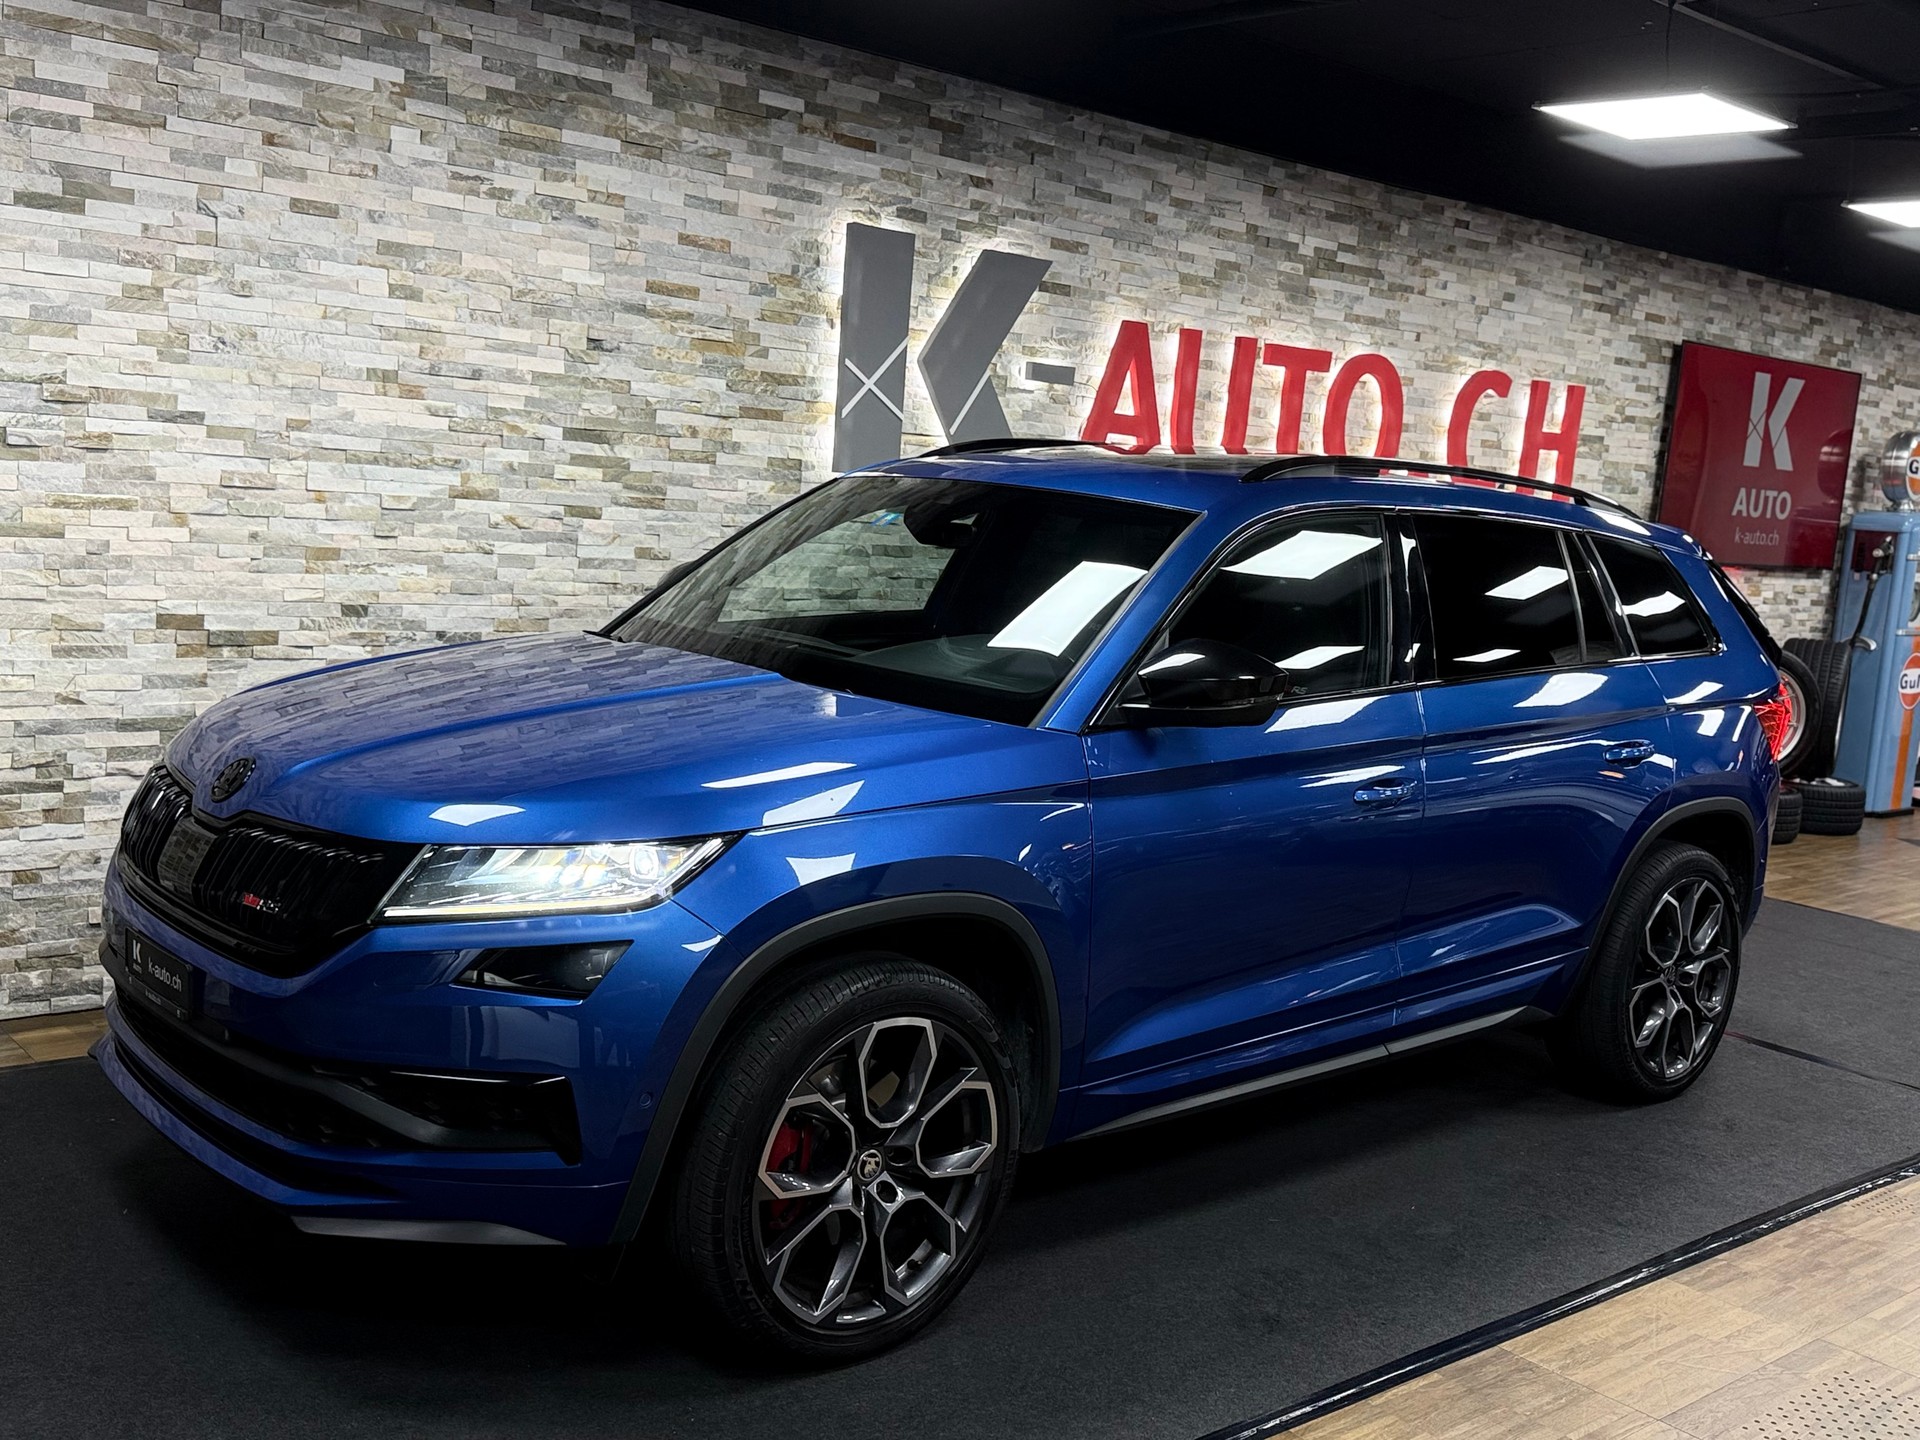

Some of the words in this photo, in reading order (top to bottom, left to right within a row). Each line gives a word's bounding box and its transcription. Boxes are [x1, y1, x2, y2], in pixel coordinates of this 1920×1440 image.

[1743, 371, 1806, 472] K
[1731, 487, 1792, 520] AUTO
[1734, 526, 1780, 546] k-auto.ch
[132, 938, 142, 964] K
[148, 956, 182, 992] k-auto.ch
